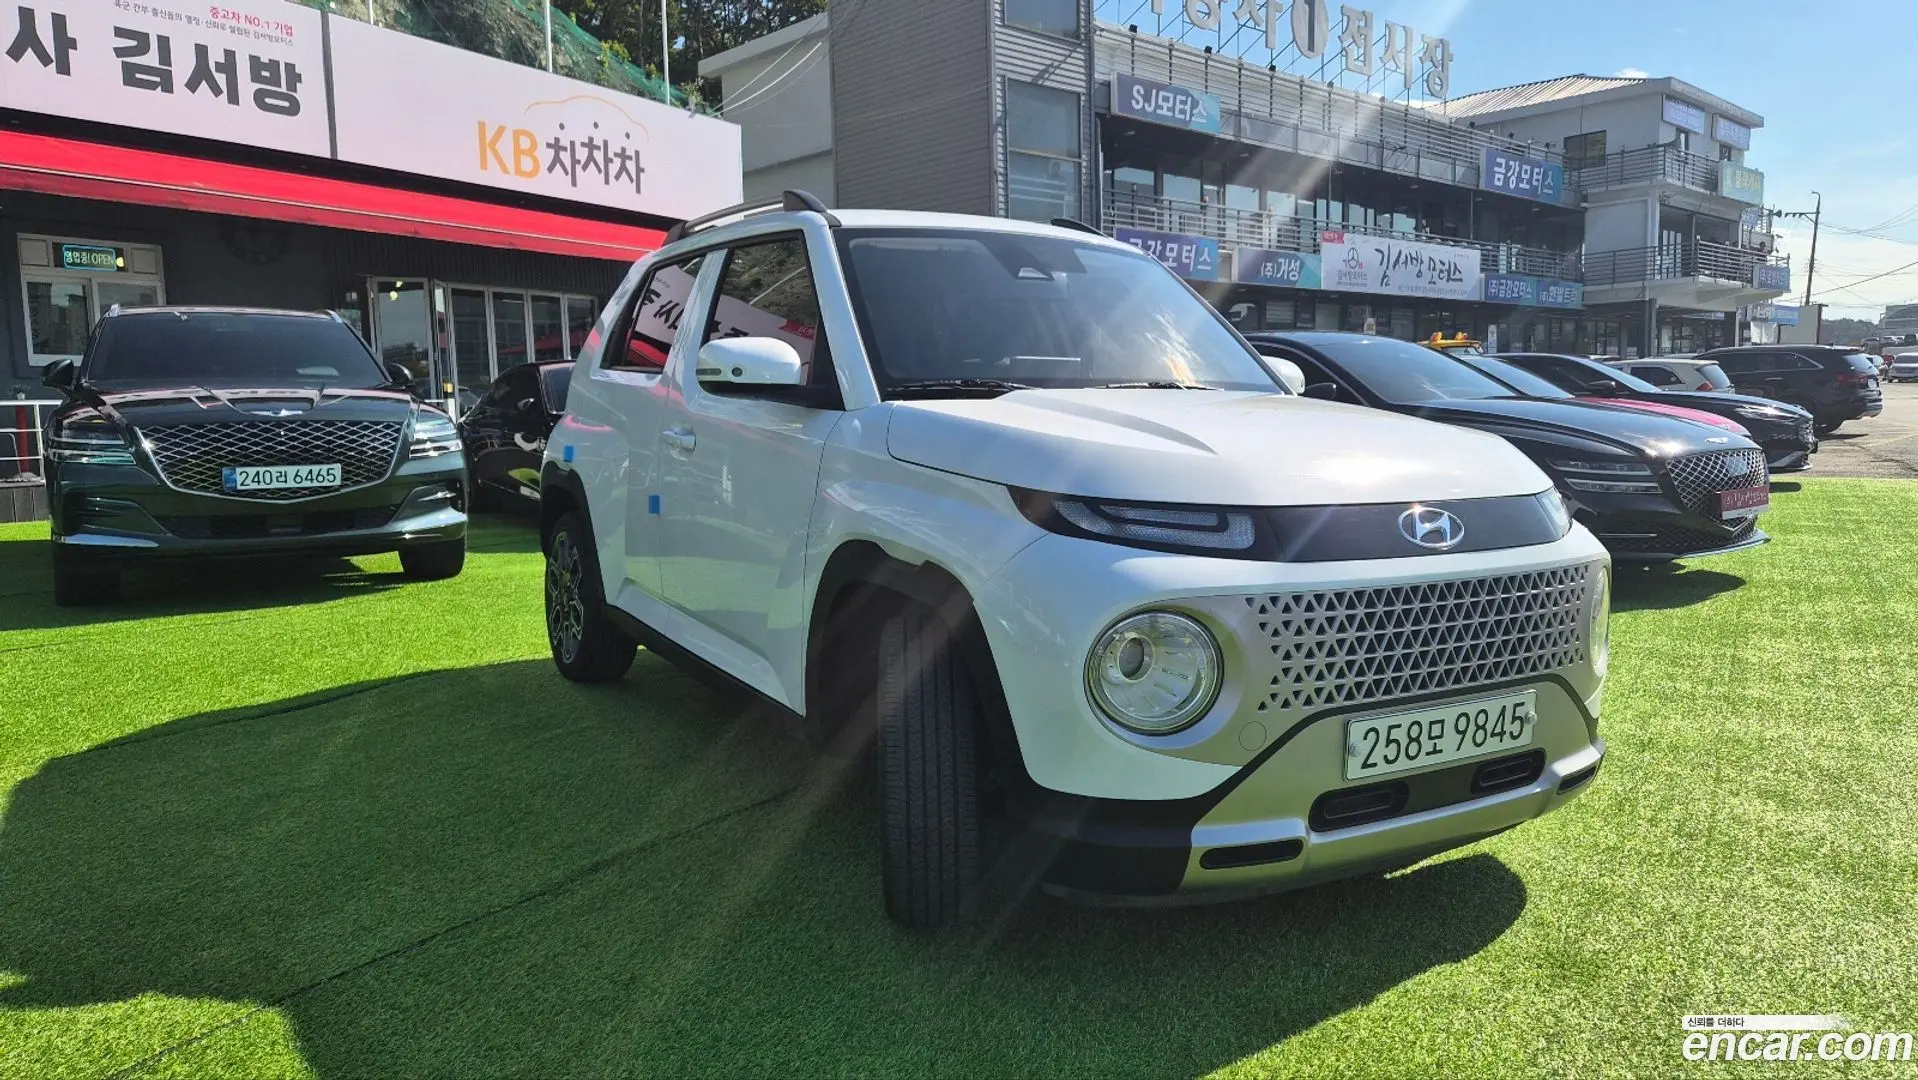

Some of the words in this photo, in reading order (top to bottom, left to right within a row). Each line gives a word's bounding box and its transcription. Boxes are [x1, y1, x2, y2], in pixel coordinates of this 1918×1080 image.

[210, 6, 240, 24] 중고차
[245, 14, 270, 30] NO.1
[274, 21, 293, 37] 기업
[5, 6, 78, 76] 사
[112, 25, 303, 117] 김서방
[1131, 84, 1208, 124] SJ모터스
[1494, 157, 1554, 195] 금강모터스
[1261, 258, 1300, 281] (주)거성
[293, 467, 336, 484] 6465
[1454, 702, 1525, 751] 9845
